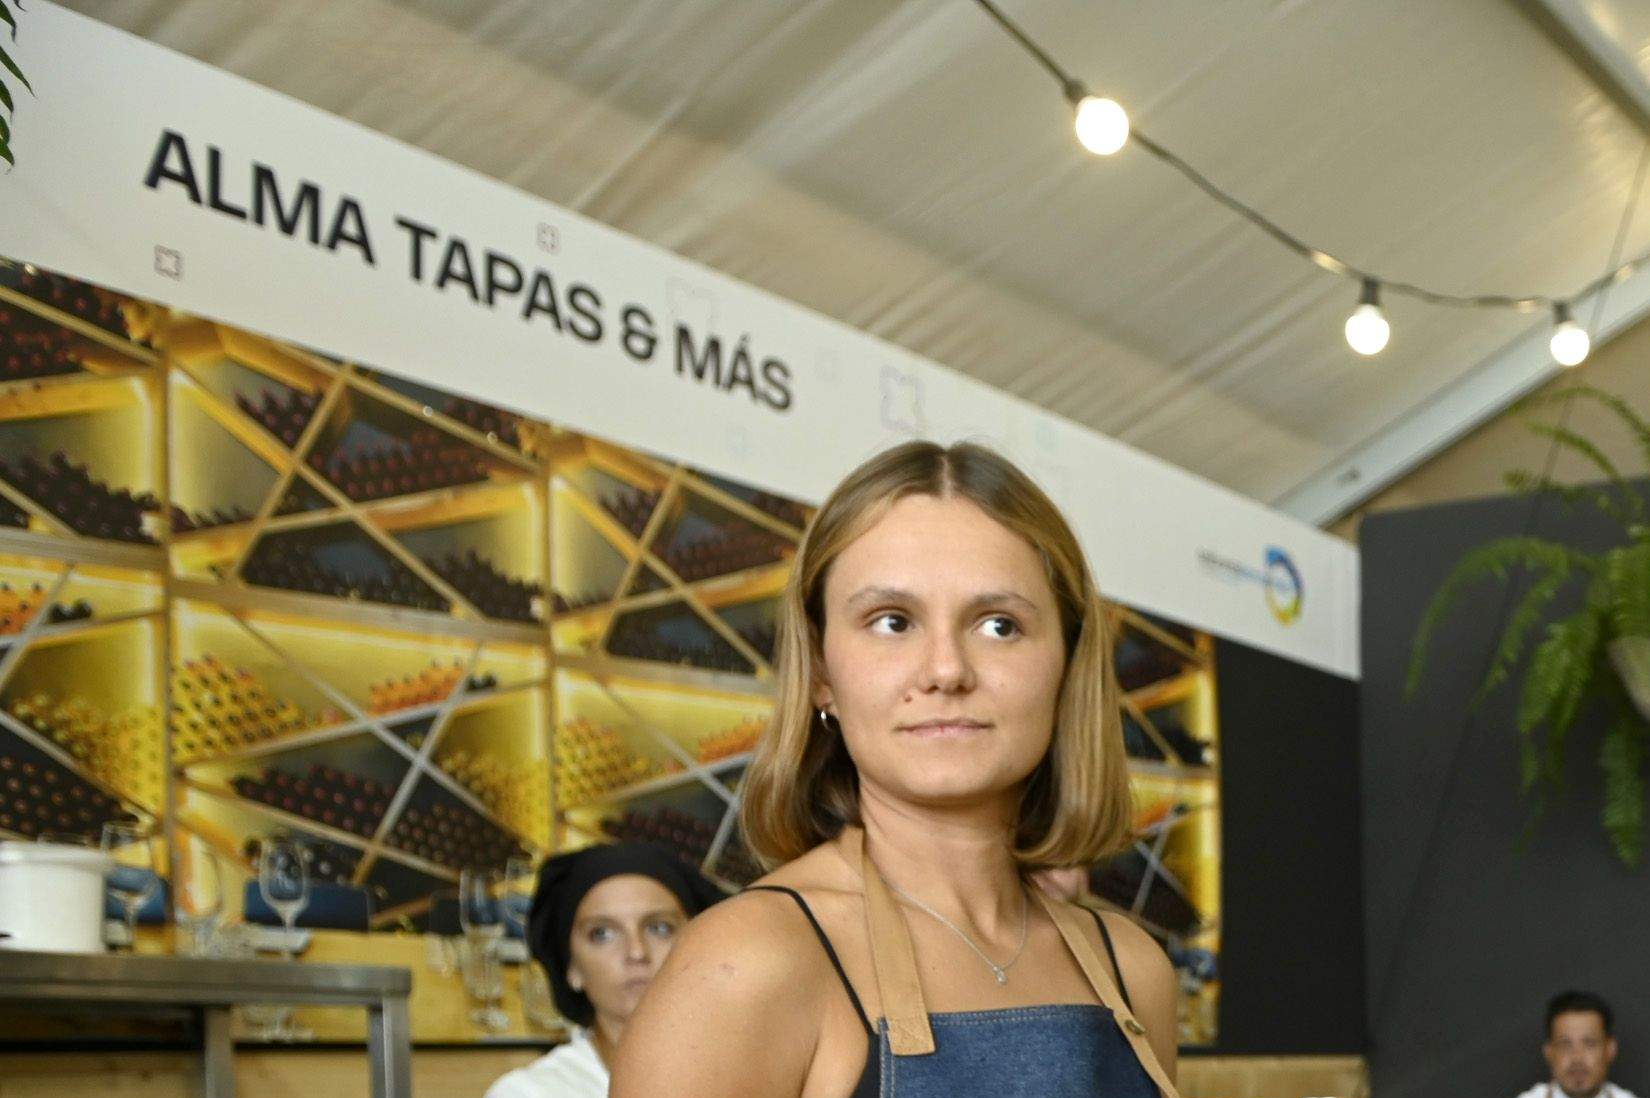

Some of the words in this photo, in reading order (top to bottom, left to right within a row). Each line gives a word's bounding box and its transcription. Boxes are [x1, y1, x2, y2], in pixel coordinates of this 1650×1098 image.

[144, 129, 374, 265] ALMA
[395, 216, 604, 344] TAPAS
[621, 305, 657, 362] &
[674, 318, 794, 412] MÁS
